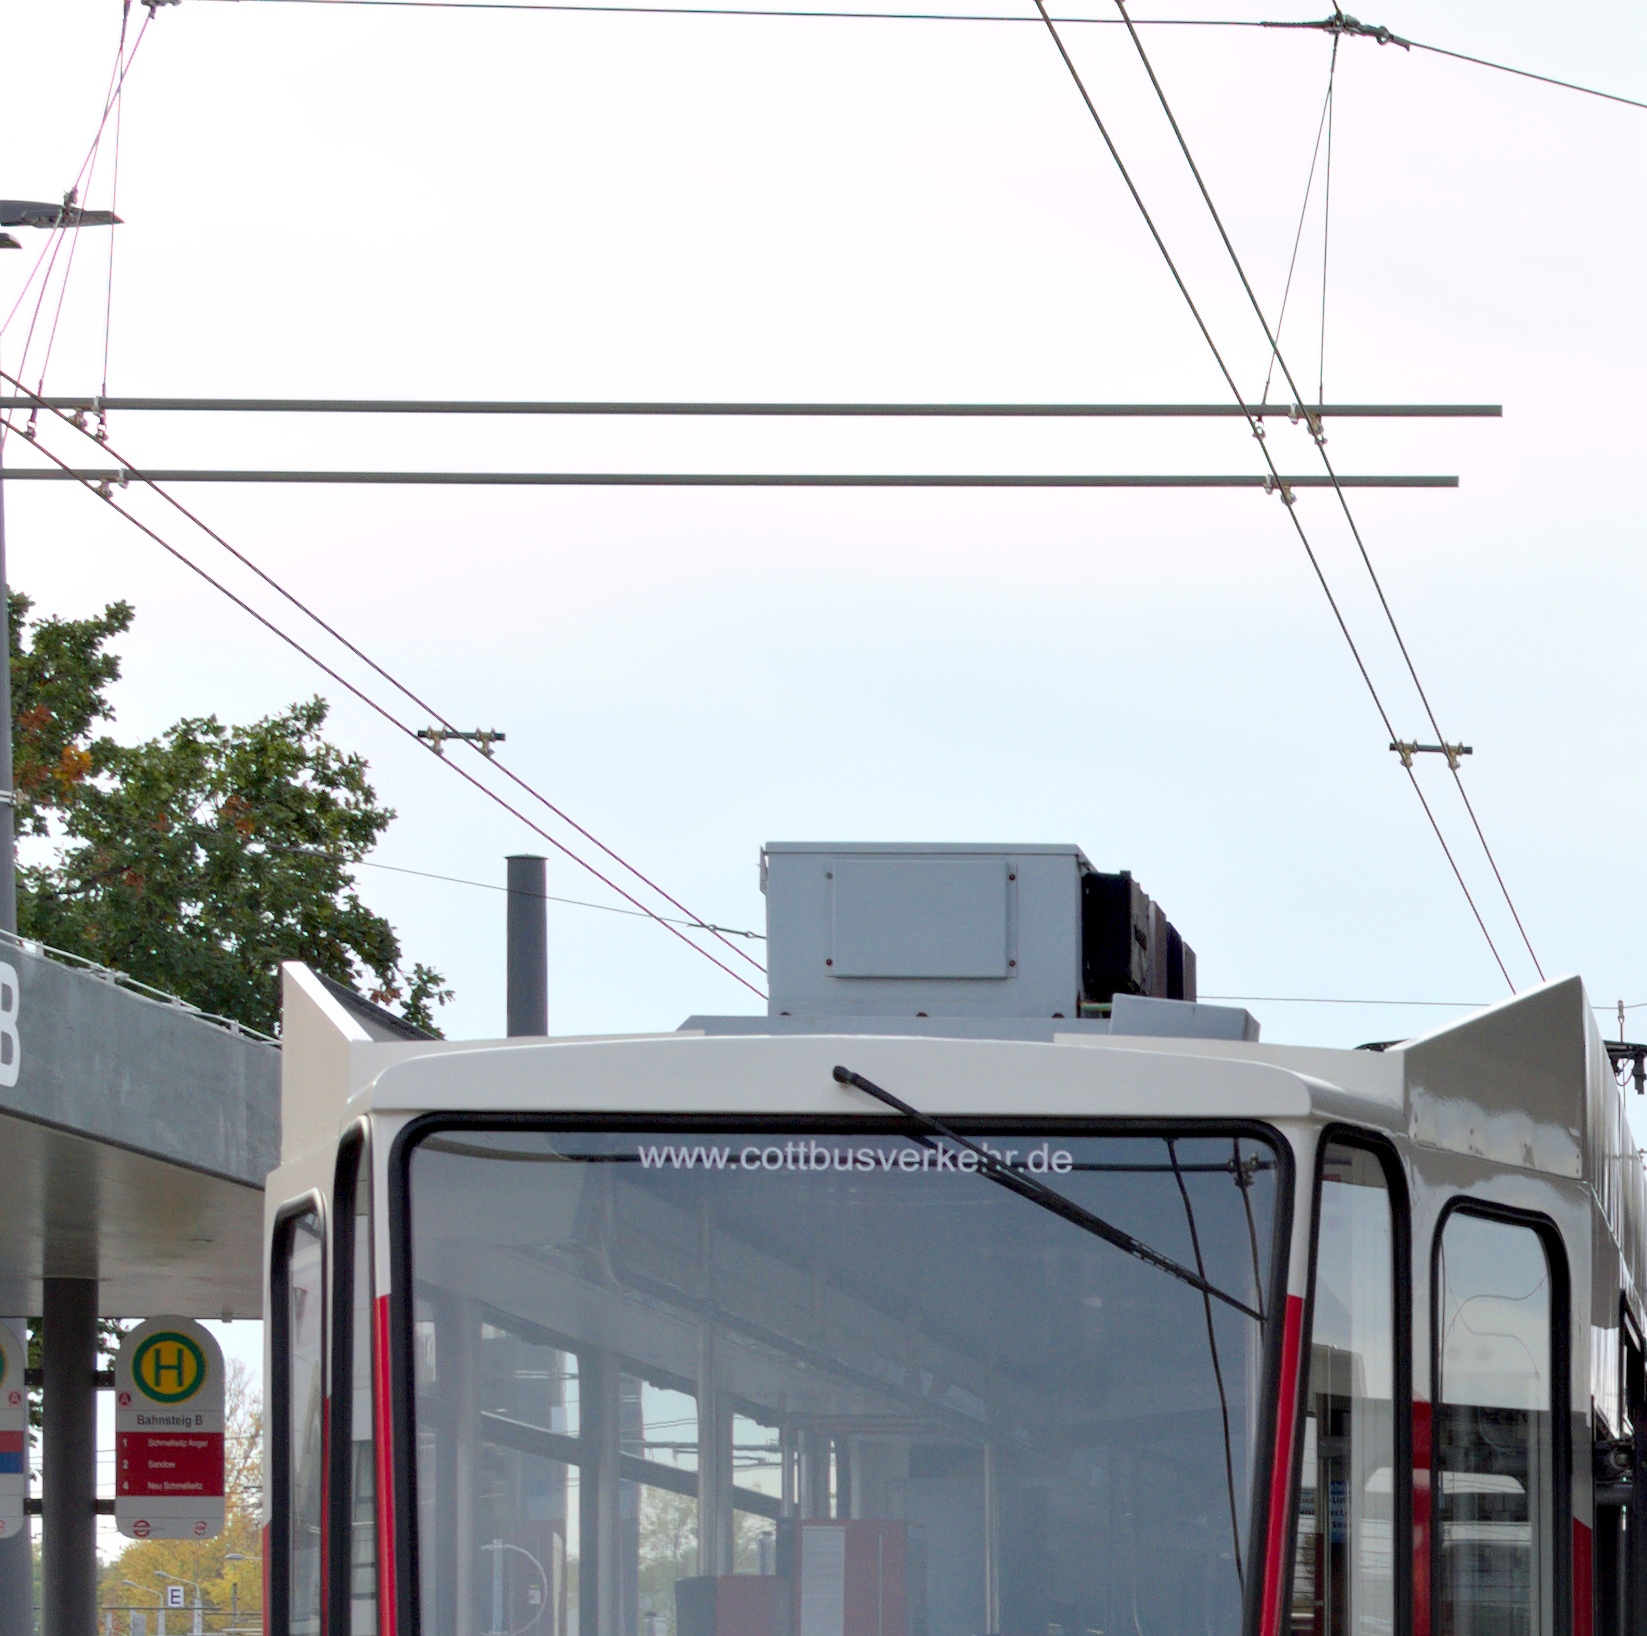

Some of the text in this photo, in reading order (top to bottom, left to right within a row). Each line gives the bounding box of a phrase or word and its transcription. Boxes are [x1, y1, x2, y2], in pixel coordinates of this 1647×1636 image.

[137, 1414, 203, 1429] Bahnsteig B
[122, 1438, 128, 1448] 1
[122, 1459, 129, 1469] 2
[122, 1481, 129, 1491] 4
[170, 1588, 181, 1604] E
